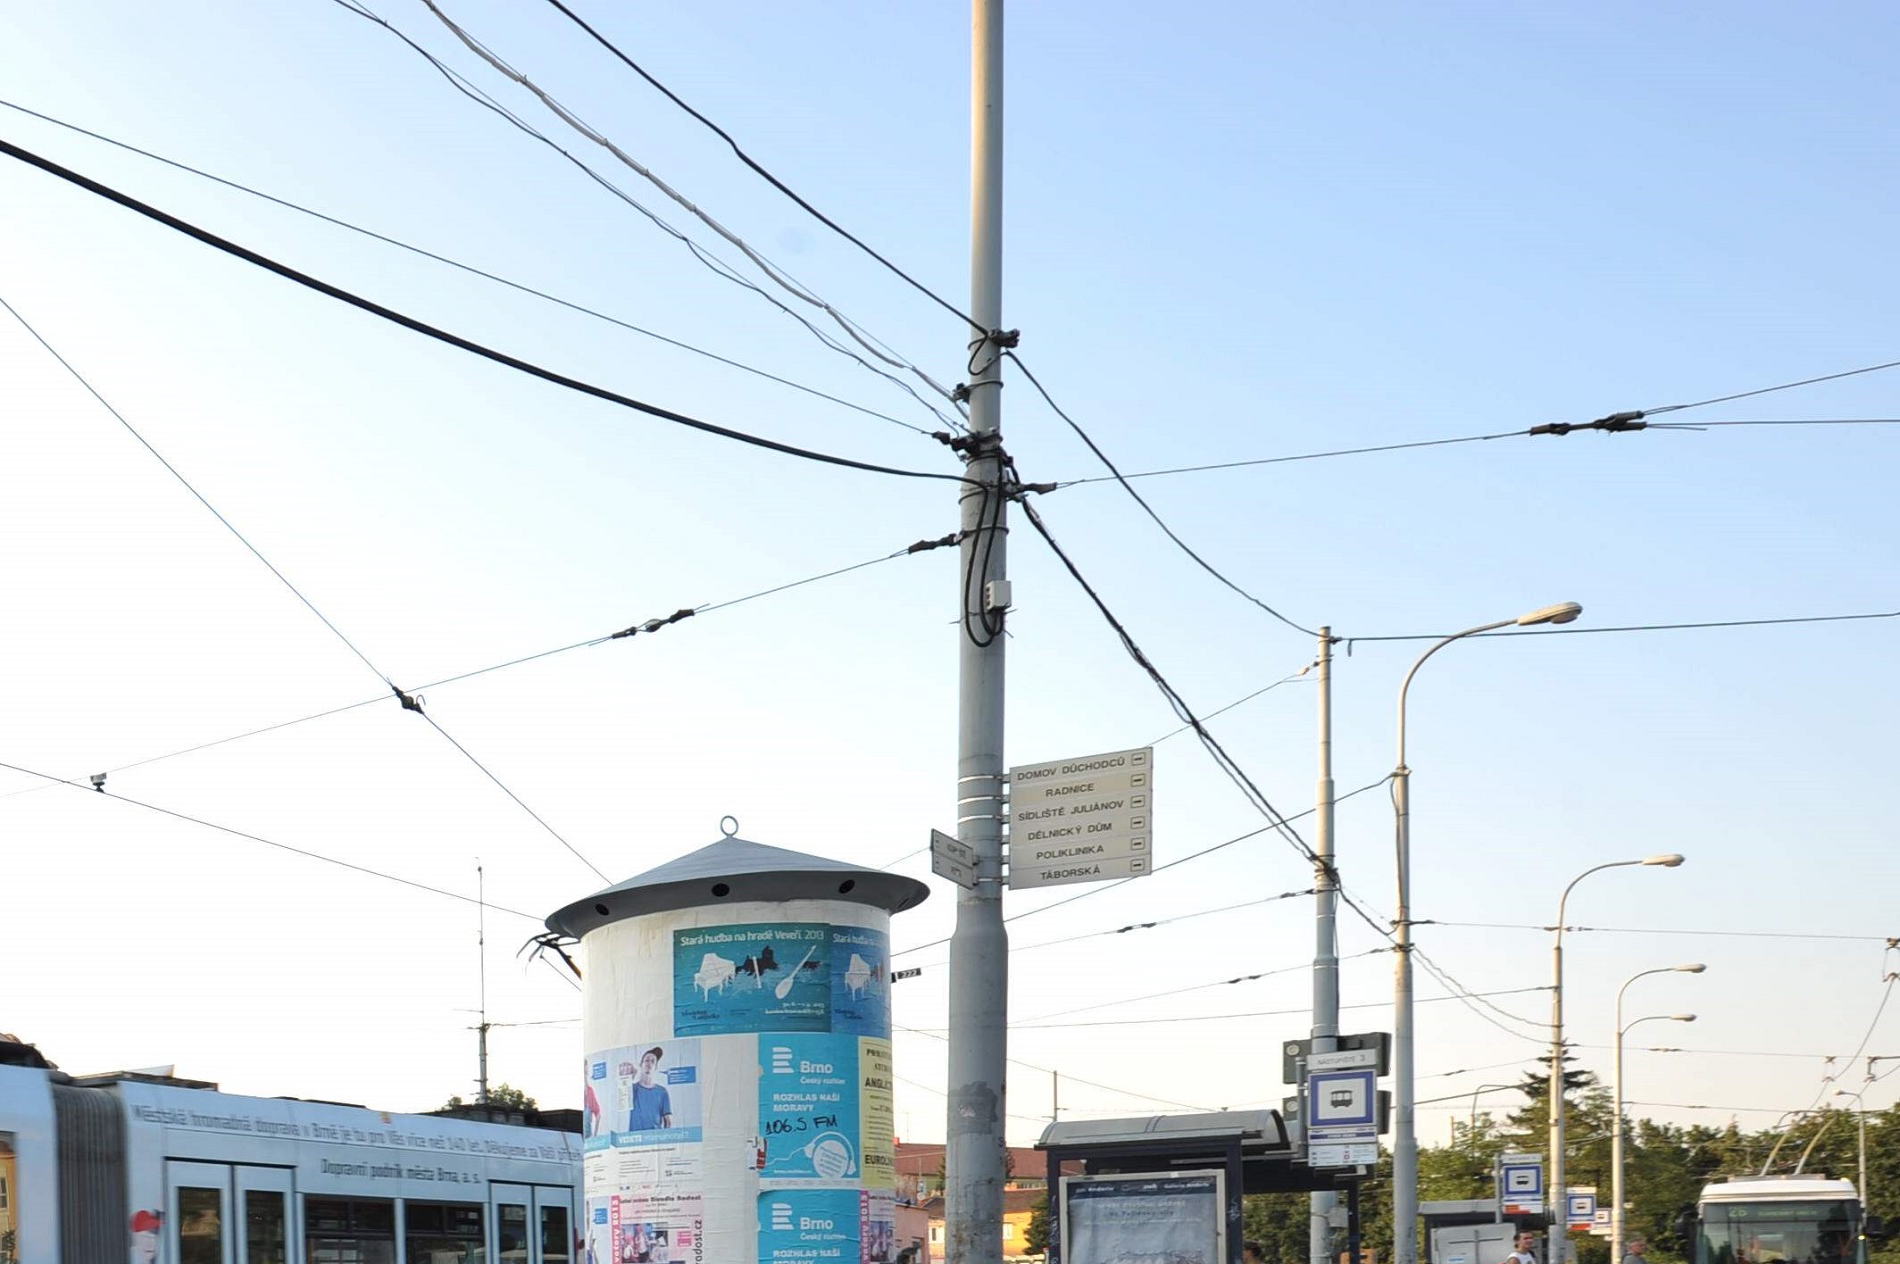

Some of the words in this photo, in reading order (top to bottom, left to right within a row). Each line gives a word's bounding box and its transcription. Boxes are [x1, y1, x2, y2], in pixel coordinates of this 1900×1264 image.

[1017, 768, 1057, 781] DOMOV
[1062, 756, 1125, 775] DŮCHODCŮ
[1045, 783, 1095, 797] RADNICE
[1018, 807, 1065, 821] SÍDLIŠTĚ
[1070, 800, 1124, 815] JULIÁNOV
[1028, 825, 1082, 841] DĚLNICKÝ
[1088, 822, 1112, 833] DŮM
[1036, 845, 1104, 860] POLIKLINIKA
[1040, 866, 1101, 880] TÁBORSKÁ
[680, 935, 704, 947] Stará
[705, 931, 733, 944] hudba
[747, 930, 773, 941] hradě
[805, 930, 825, 940] 2013
[833, 933, 851, 944] Stará
[800, 1061, 833, 1074] Brno
[773, 1093, 817, 1102] ROZHLAS
[773, 1104, 814, 1112] MORAVY
[765, 1118, 807, 1135] 106.5
[813, 1115, 838, 1128] FM
[321, 1158, 368, 1177] Dopravní
[407, 1165, 434, 1180] města
[1729, 1206, 1748, 1217] 26
[800, 1217, 833, 1230] Brno
[773, 1250, 817, 1258] ROZHLAS
